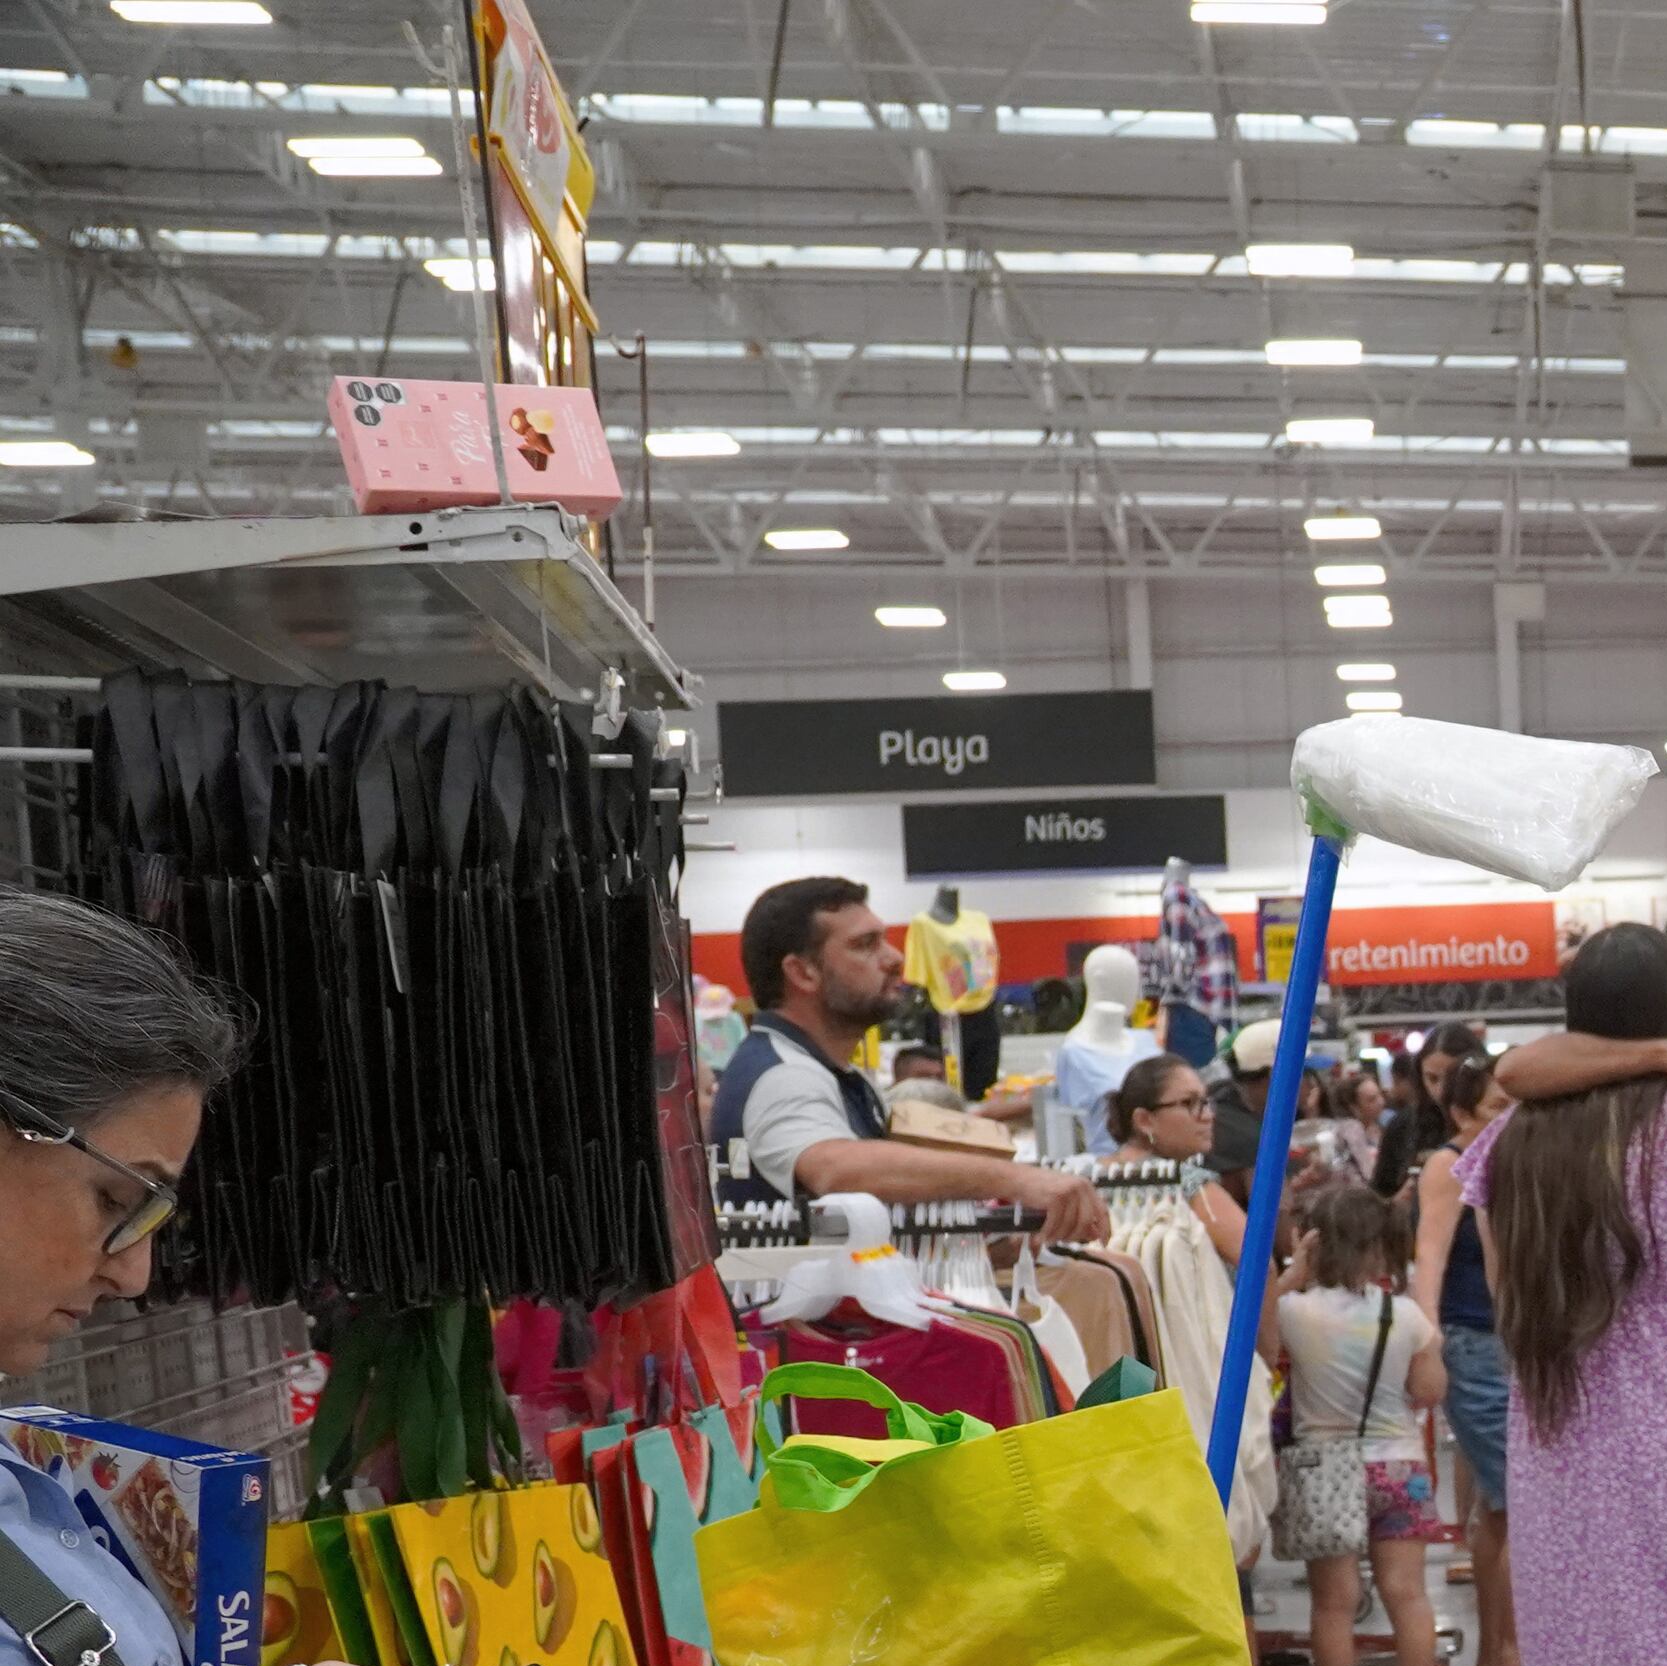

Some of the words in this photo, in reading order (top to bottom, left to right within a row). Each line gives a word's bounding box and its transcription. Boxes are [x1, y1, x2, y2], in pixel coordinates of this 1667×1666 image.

[880, 729, 990, 775] Playa
[1025, 812, 1106, 842] Niños
[1330, 934, 1531, 972] retenimiento
